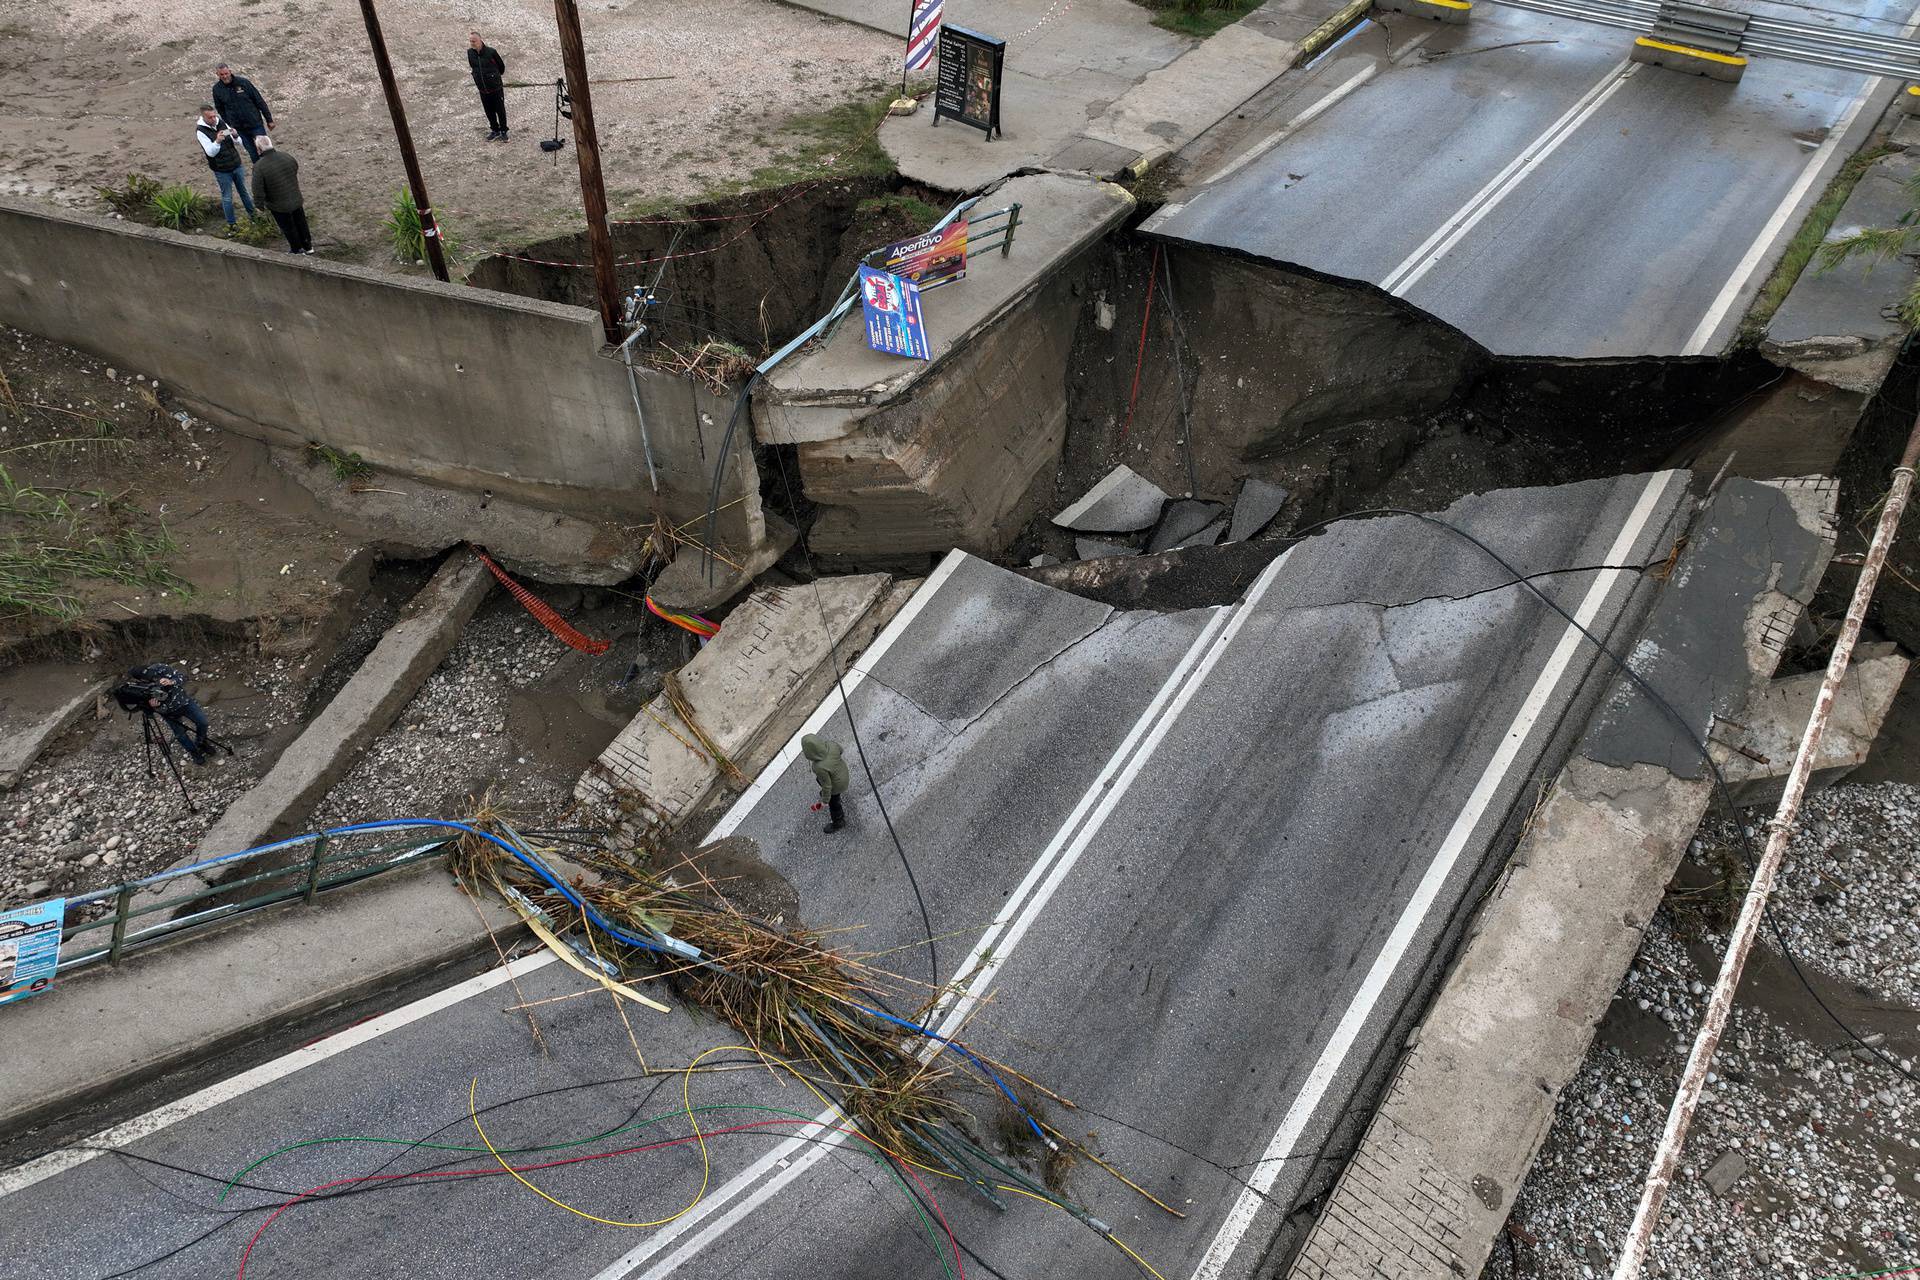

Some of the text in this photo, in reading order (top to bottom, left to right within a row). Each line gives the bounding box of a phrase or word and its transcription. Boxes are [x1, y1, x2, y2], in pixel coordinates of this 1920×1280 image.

[891, 235, 943, 258] Aperitivo
[875, 278, 888, 310] BOAT
[24, 926, 43, 934] GREEK
